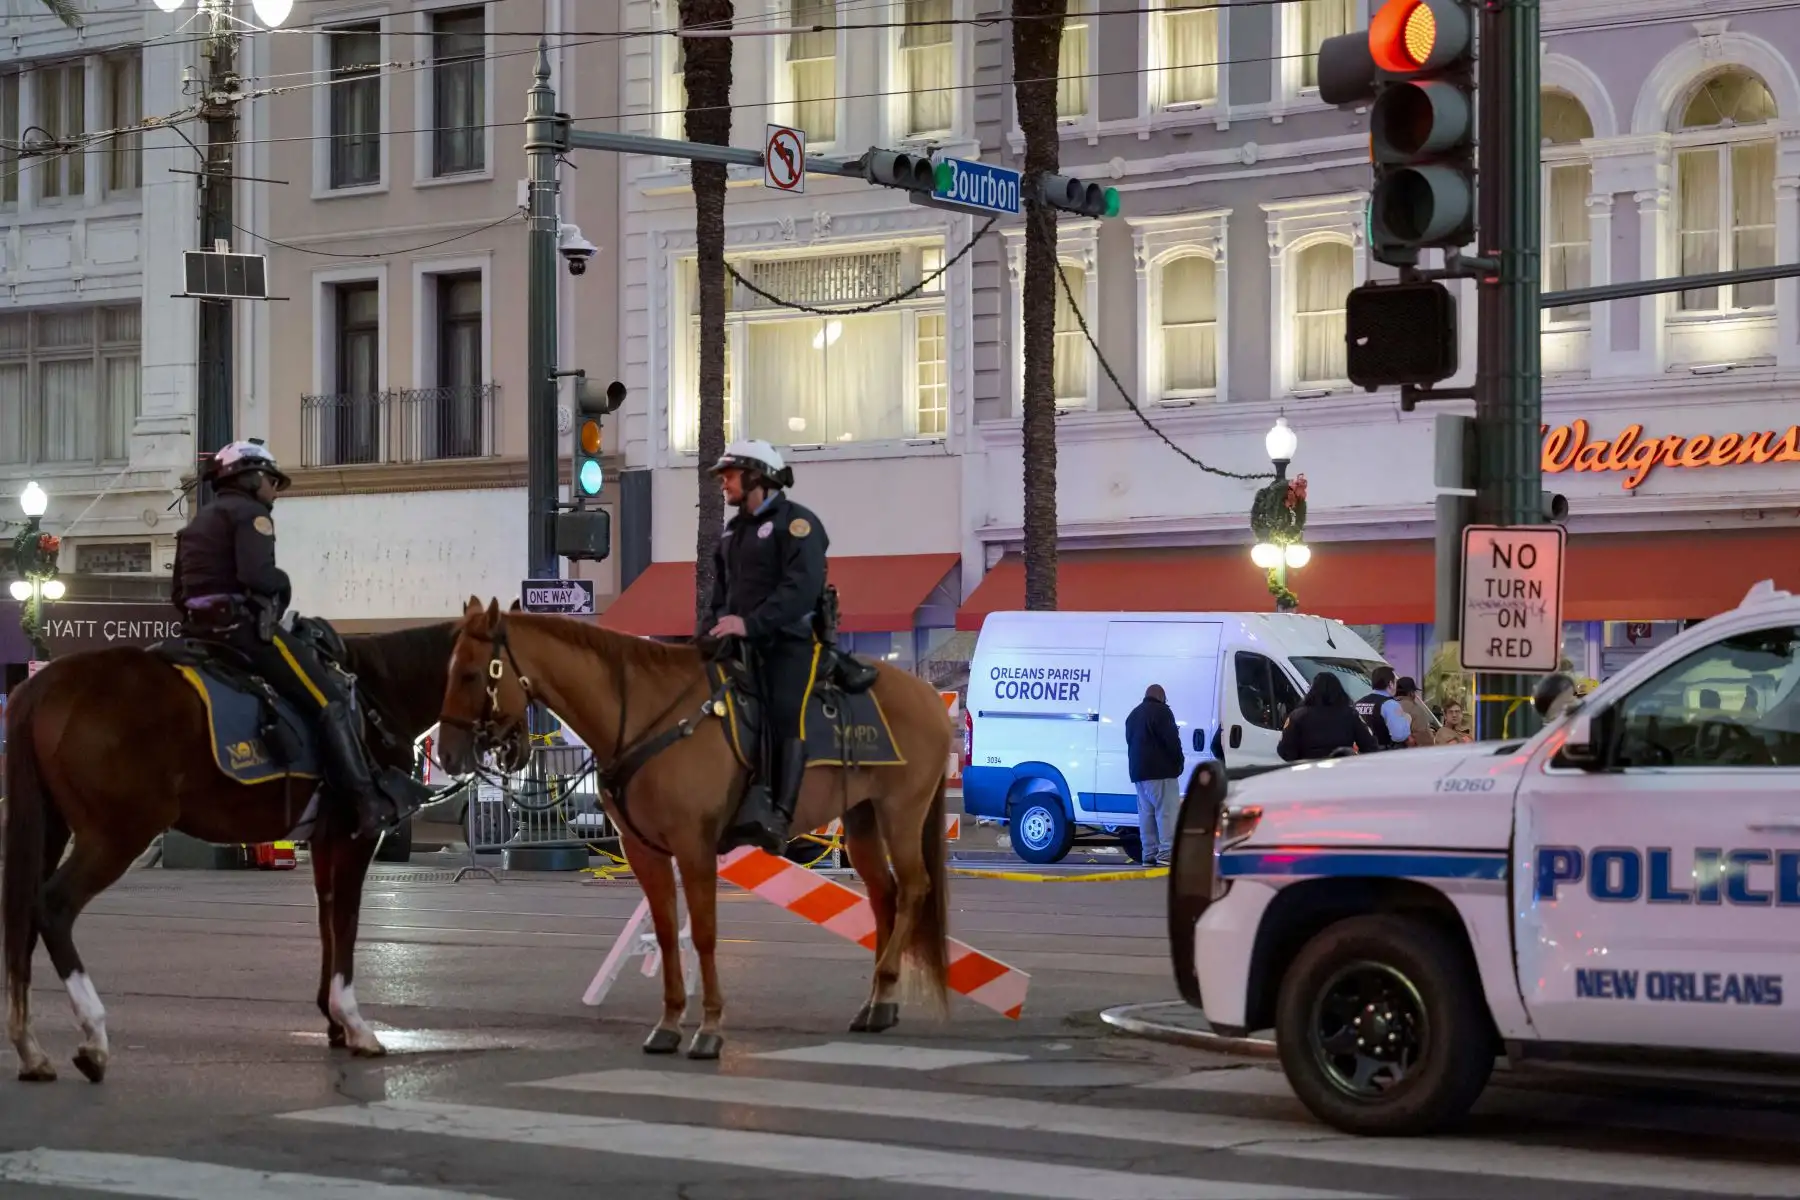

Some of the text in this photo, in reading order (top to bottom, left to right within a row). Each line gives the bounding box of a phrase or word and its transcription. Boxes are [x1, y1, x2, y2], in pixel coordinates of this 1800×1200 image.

[946, 160, 1016, 211] Bourbon
[1540, 418, 1800, 490] Walgreens
[1492, 543, 1537, 569] NO
[529, 590, 573, 604] ONE WAY
[1485, 578, 1542, 599] TURN
[1498, 608, 1527, 629] ON
[42, 619, 182, 641] HYATT CENTRIC
[1490, 637, 1532, 658] RED
[990, 666, 1091, 683] ORLEANS PARISH
[994, 680, 1080, 701] CORONER
[986, 756, 1002, 765] 3034
[1575, 968, 1783, 1006] NEW ORLEANS
